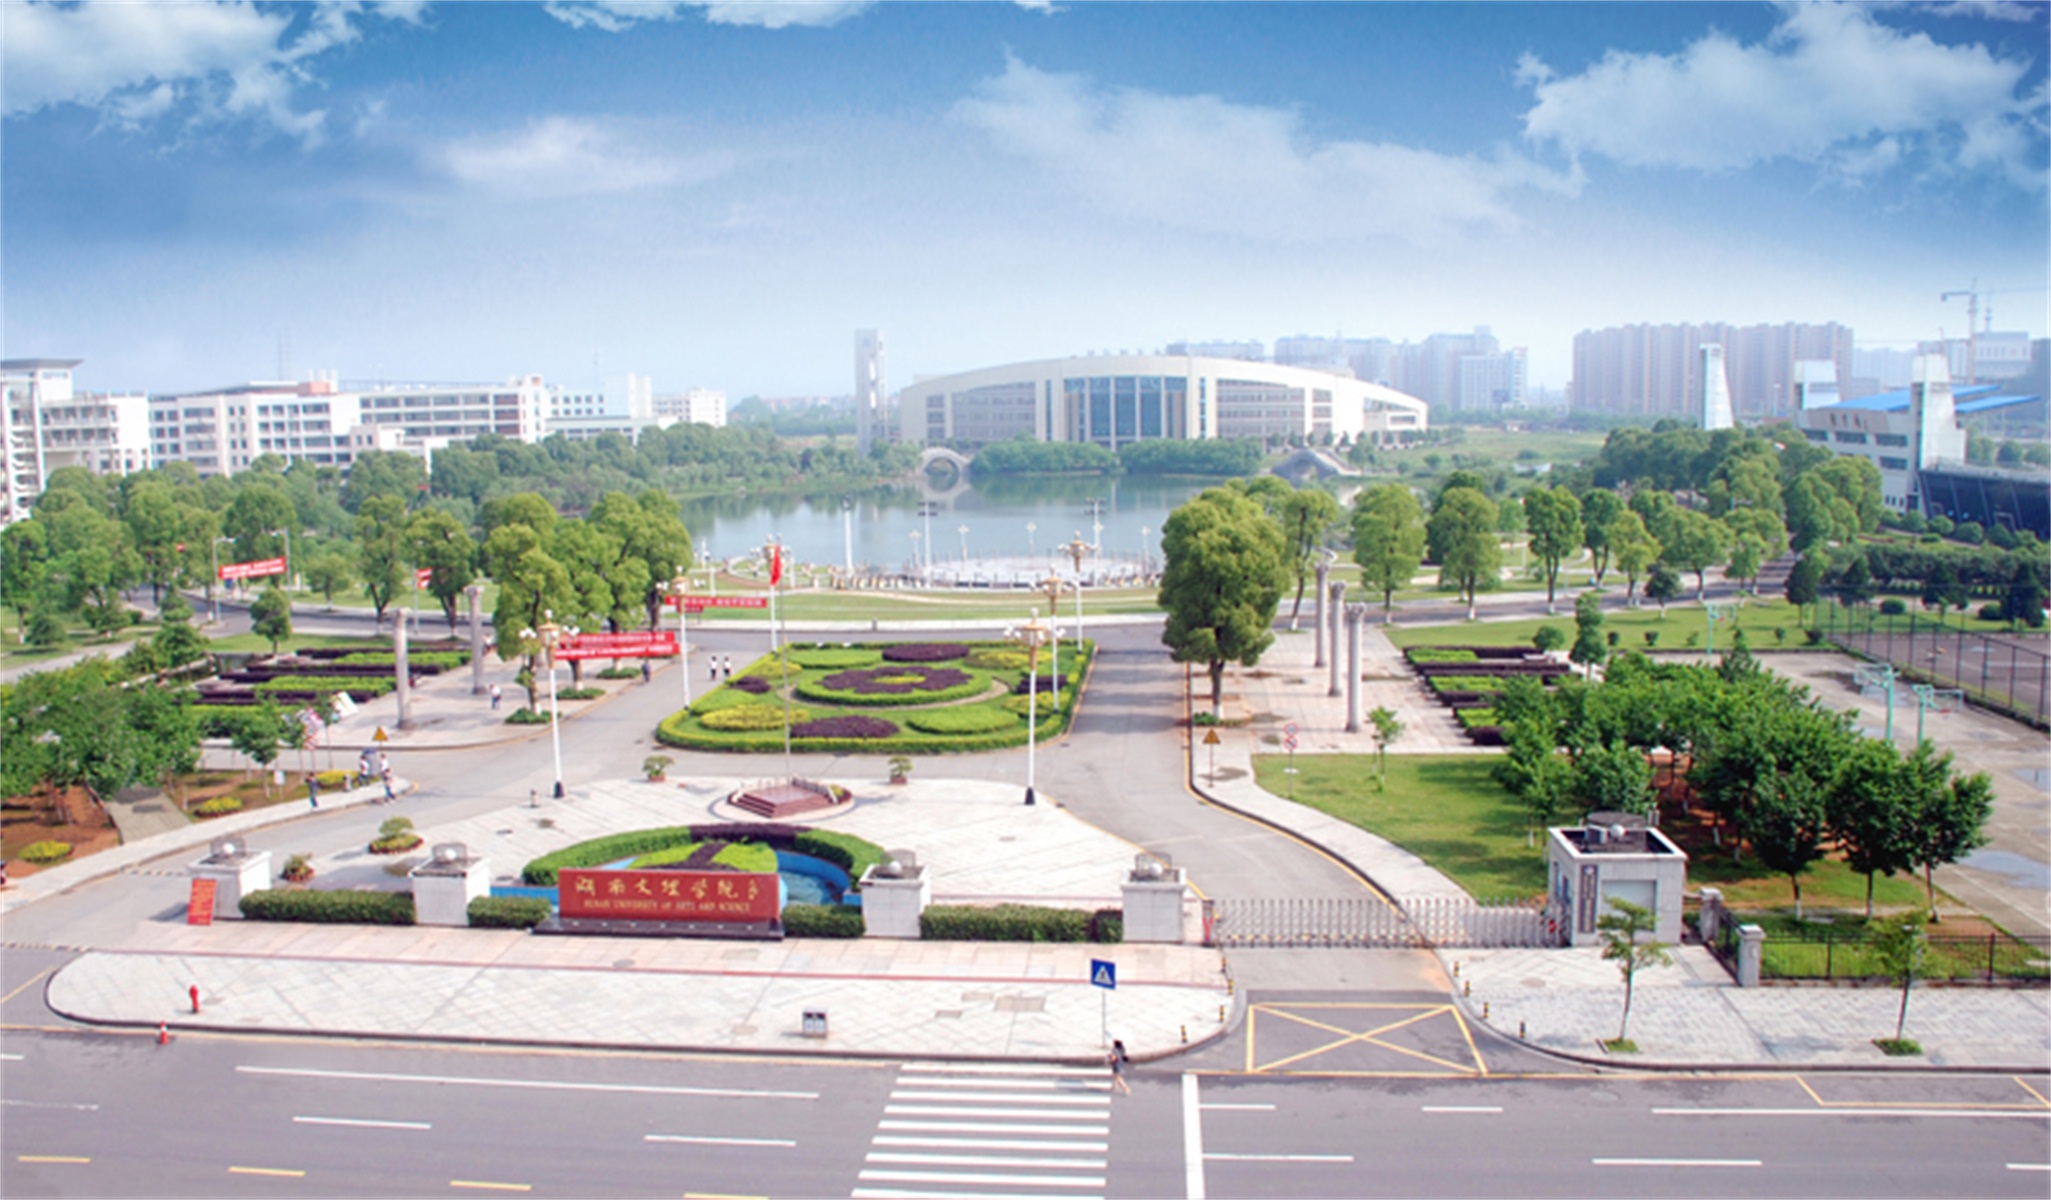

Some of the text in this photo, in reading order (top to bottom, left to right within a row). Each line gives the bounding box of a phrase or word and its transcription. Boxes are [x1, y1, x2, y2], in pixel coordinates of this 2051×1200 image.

[583, 899, 611, 909] HUNAN
[613, 899, 658, 910] UNIVERSITY
[699, 902, 716, 912] AND
